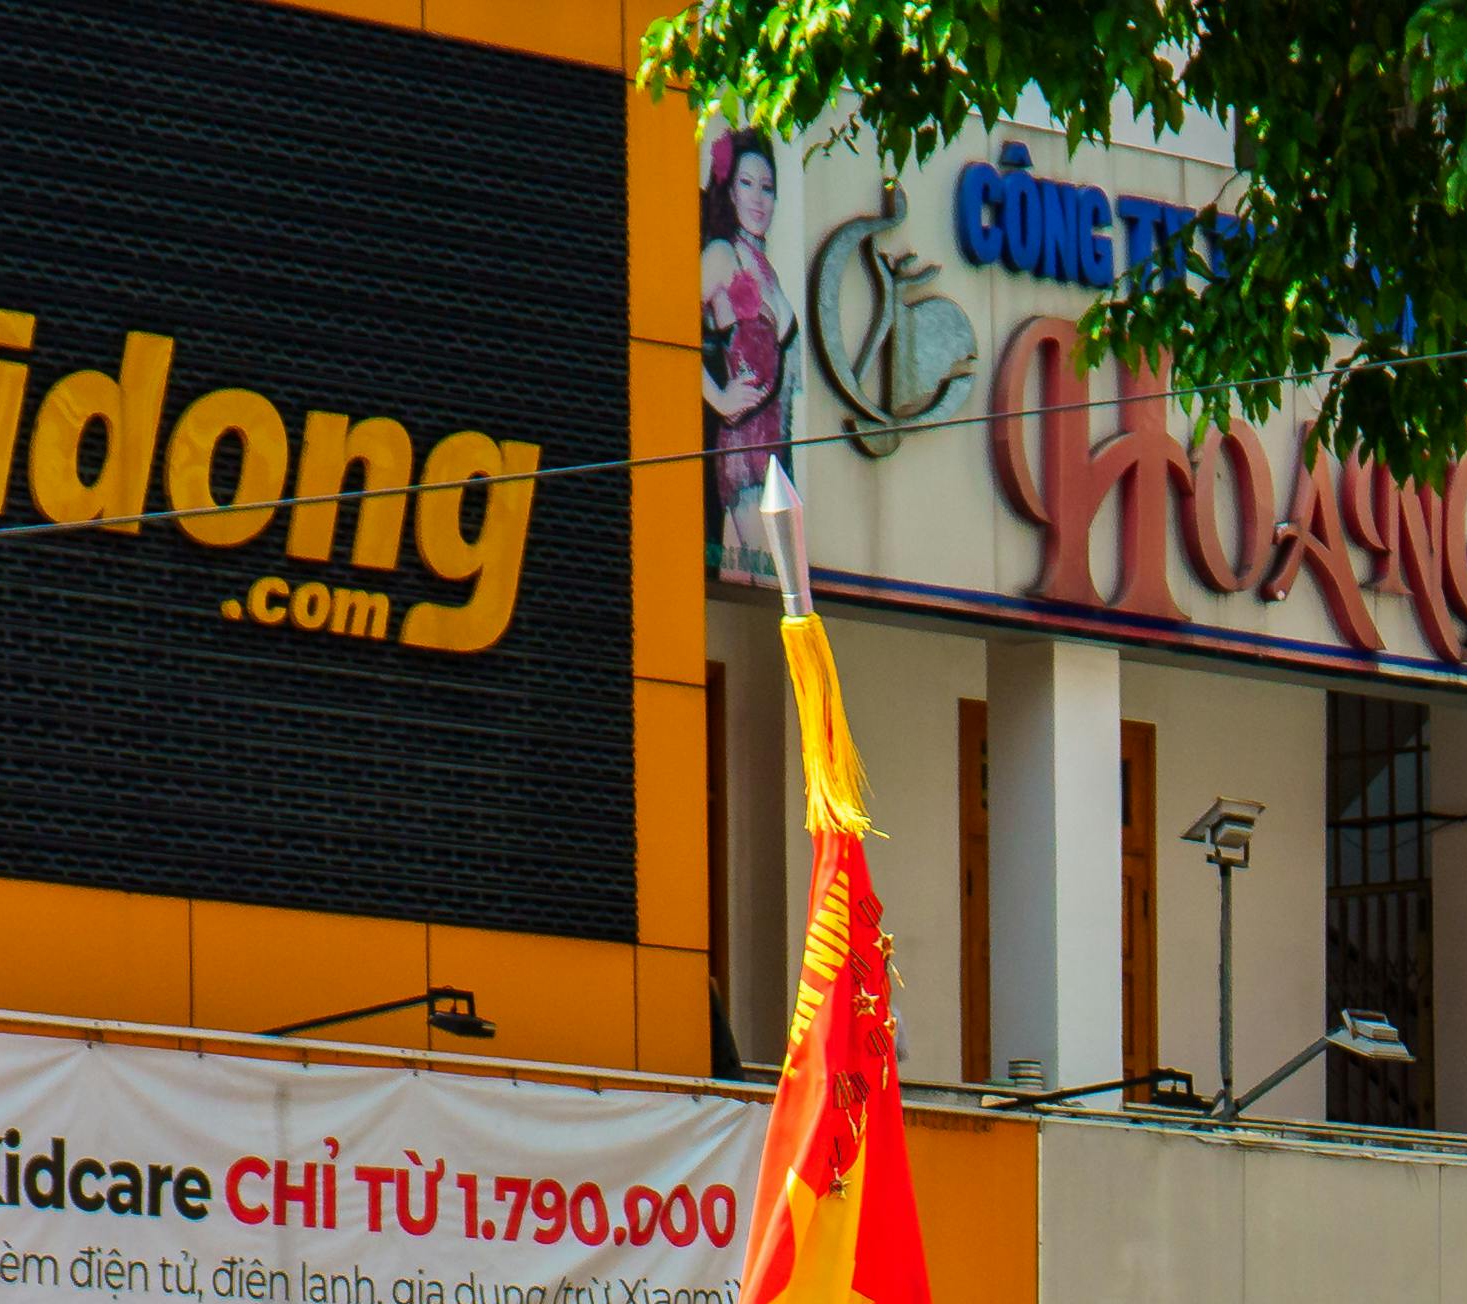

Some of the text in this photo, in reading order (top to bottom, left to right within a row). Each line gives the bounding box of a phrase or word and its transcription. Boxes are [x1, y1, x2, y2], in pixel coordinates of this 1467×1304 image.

[954, 140, 1116, 290] CÔNG
[221, 576, 391, 641] .com
[225, 1136, 340, 1230] CHỈ
[354, 1149, 446, 1237] TỪ
[456, 1172, 737, 1249] 1.790.000
[70, 1246, 149, 1300] điện
